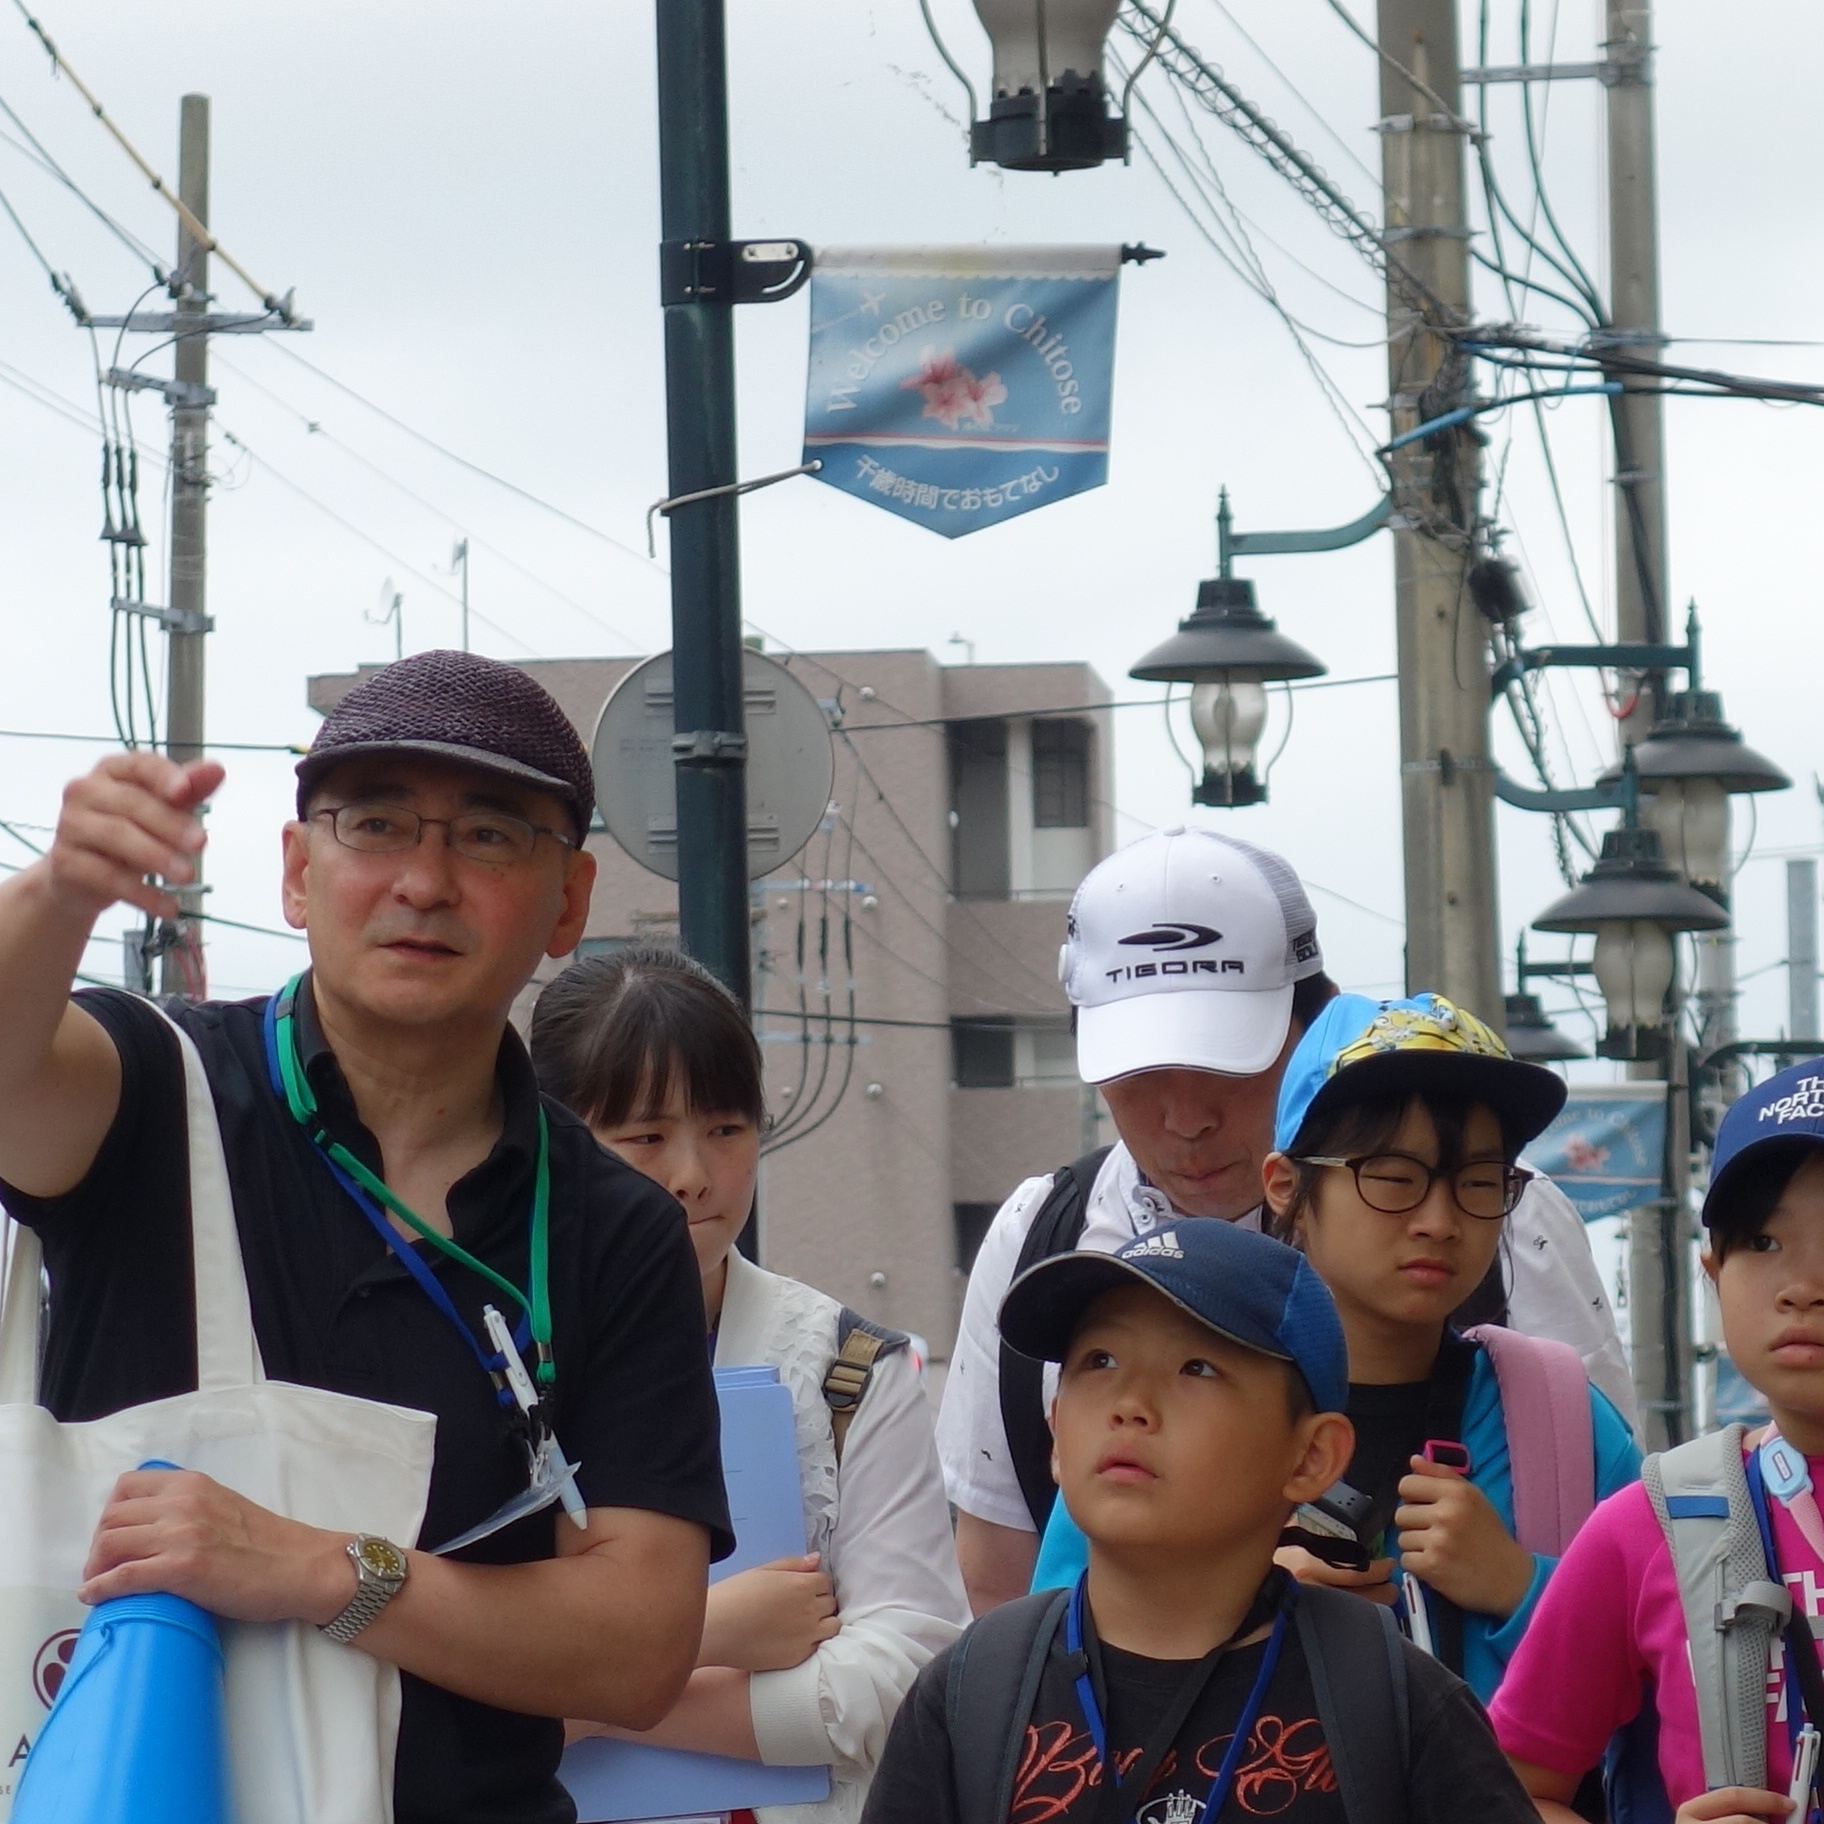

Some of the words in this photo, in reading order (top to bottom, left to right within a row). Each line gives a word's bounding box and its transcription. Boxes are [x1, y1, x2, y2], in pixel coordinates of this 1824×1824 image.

[827, 297, 946, 414] Welcome
[958, 291, 993, 321] to
[1003, 302, 1084, 416] Chitose
[855, 453, 1061, 511] 千歳時間でおもてなし
[1106, 960, 1245, 983] TIGORA
[1121, 1246, 1185, 1259] adidas
